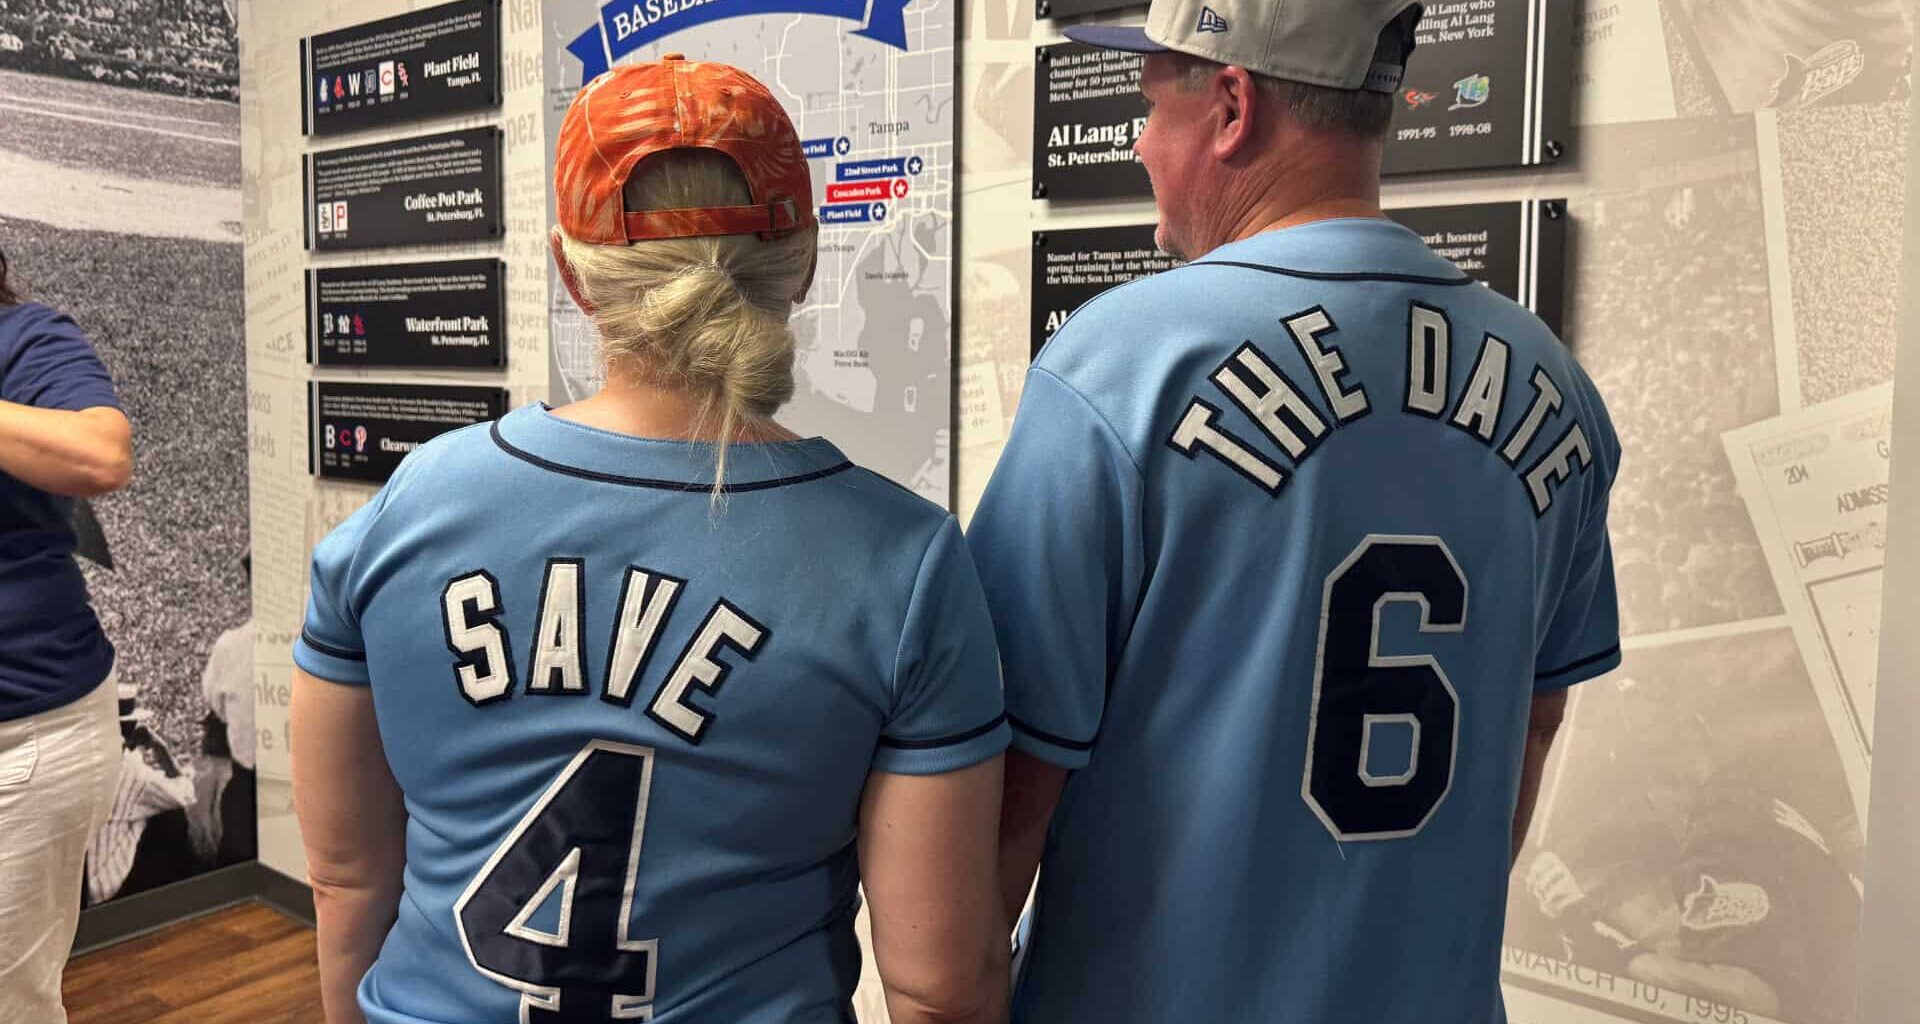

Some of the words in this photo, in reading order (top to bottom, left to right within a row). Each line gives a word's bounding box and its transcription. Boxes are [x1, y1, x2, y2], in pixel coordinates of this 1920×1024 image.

[1424, 4, 1436, 17] Al
[1439, 2, 1468, 15] Lang
[1469, 0, 1495, 10] who
[1415, 18, 1449, 31] alling
[1450, 15, 1463, 28] Al
[1465, 13, 1495, 25] Lang
[1415, 34, 1436, 45] nts,
[1439, 30, 1465, 42] New
[1467, 26, 1494, 39] York
[424, 59, 451, 78] Plant
[452, 52, 480, 72] Field
[1051, 57, 1070, 68] Built
[1072, 55, 1081, 65] in
[1102, 50, 1119, 61] this
[1049, 62, 1101, 80] championed
[1103, 57, 1140, 72] baseball
[447, 75, 471, 88] Tampa,
[472, 74, 481, 84] FL
[1050, 80, 1073, 91] home
[1075, 78, 1087, 88] for
[1101, 74, 1127, 87] years.
[1049, 92, 1072, 103] Mets,
[1073, 88, 1115, 100] Baltimore
[506, 112, 537, 155] pez
[869, 122, 910, 136] Tampa
[1048, 124, 1070, 147] Al
[1073, 121, 1129, 147] Lang
[1397, 126, 1436, 141] 1991-95
[1449, 122, 1492, 137] 1998-08
[882, 163, 898, 173] Park
[1048, 153, 1066, 168] St.
[404, 193, 438, 211] Coffee
[438, 191, 456, 206] Pot
[457, 188, 483, 204] Park
[865, 187, 882, 196] Park
[437, 209, 474, 222] Petersburg,
[1423, 232, 1444, 245] ark
[1446, 229, 1488, 244] hosted
[1047, 252, 1076, 263] Named
[1077, 251, 1090, 261] for
[1093, 251, 1122, 263] Tampa
[1124, 248, 1151, 259] native
[1433, 246, 1472, 259] nager
[1474, 243, 1488, 255] of
[1047, 263, 1074, 275] spring
[1075, 262, 1110, 273] training
[1111, 261, 1124, 271] for
[1126, 260, 1141, 270] the
[1143, 259, 1170, 270] White
[1047, 275, 1060, 285] the
[1061, 273, 1086, 284] White
[1088, 272, 1103, 283] Sox
[1104, 272, 1113, 282] in
[405, 317, 462, 333] Waterfront
[463, 315, 489, 332] Park
[441, 334, 479, 348] Petersburg,
[1165, 305, 1371, 498] THE
[1402, 299, 1593, 519] DATE
[1837, 484, 1888, 514] ADMISS
[441, 557, 773, 745] SAVE
[1301, 534, 1469, 842] 6
[453, 739, 660, 1024] 4
[1503, 946, 1616, 993] MARCH
